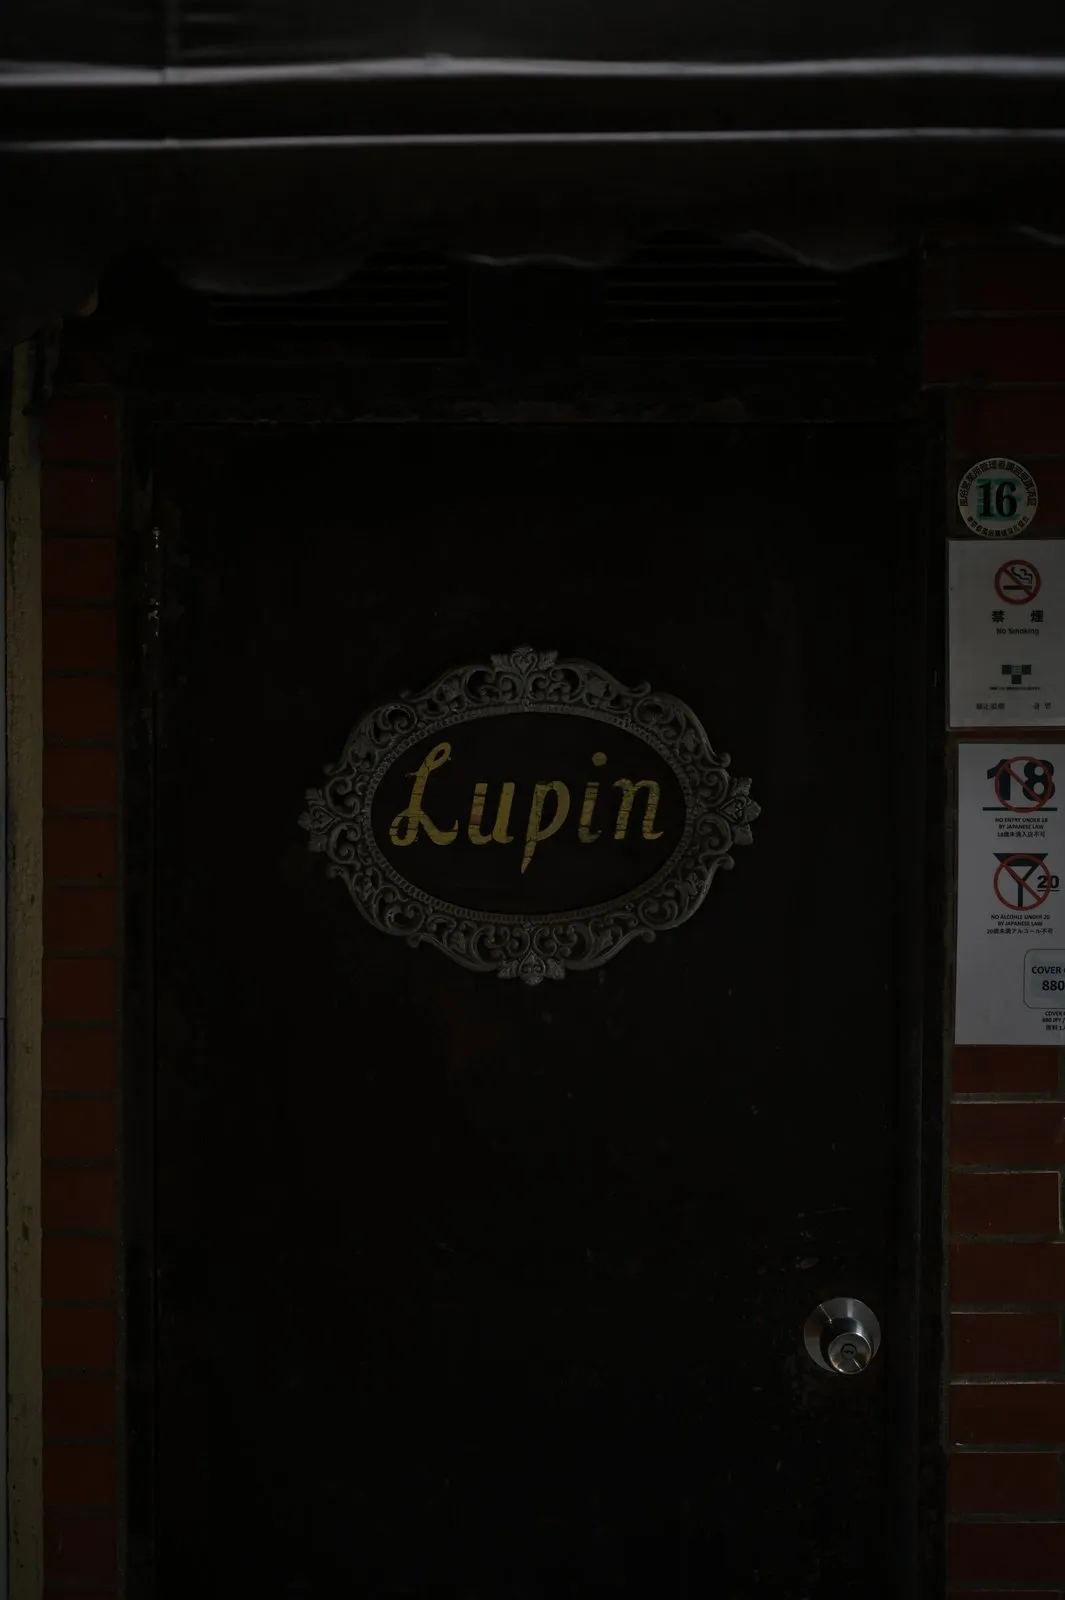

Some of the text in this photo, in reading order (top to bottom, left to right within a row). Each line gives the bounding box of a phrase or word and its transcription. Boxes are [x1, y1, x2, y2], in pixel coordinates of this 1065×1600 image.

[977, 480, 1018, 518] 16
[996, 627, 1040, 636] No Smoking
[987, 758, 1056, 802] 18
[388, 741, 665, 875] Lupin
[1037, 875, 1060, 889] 20
[1031, 966, 1061, 974] COVER
[1042, 980, 1065, 991] 880
